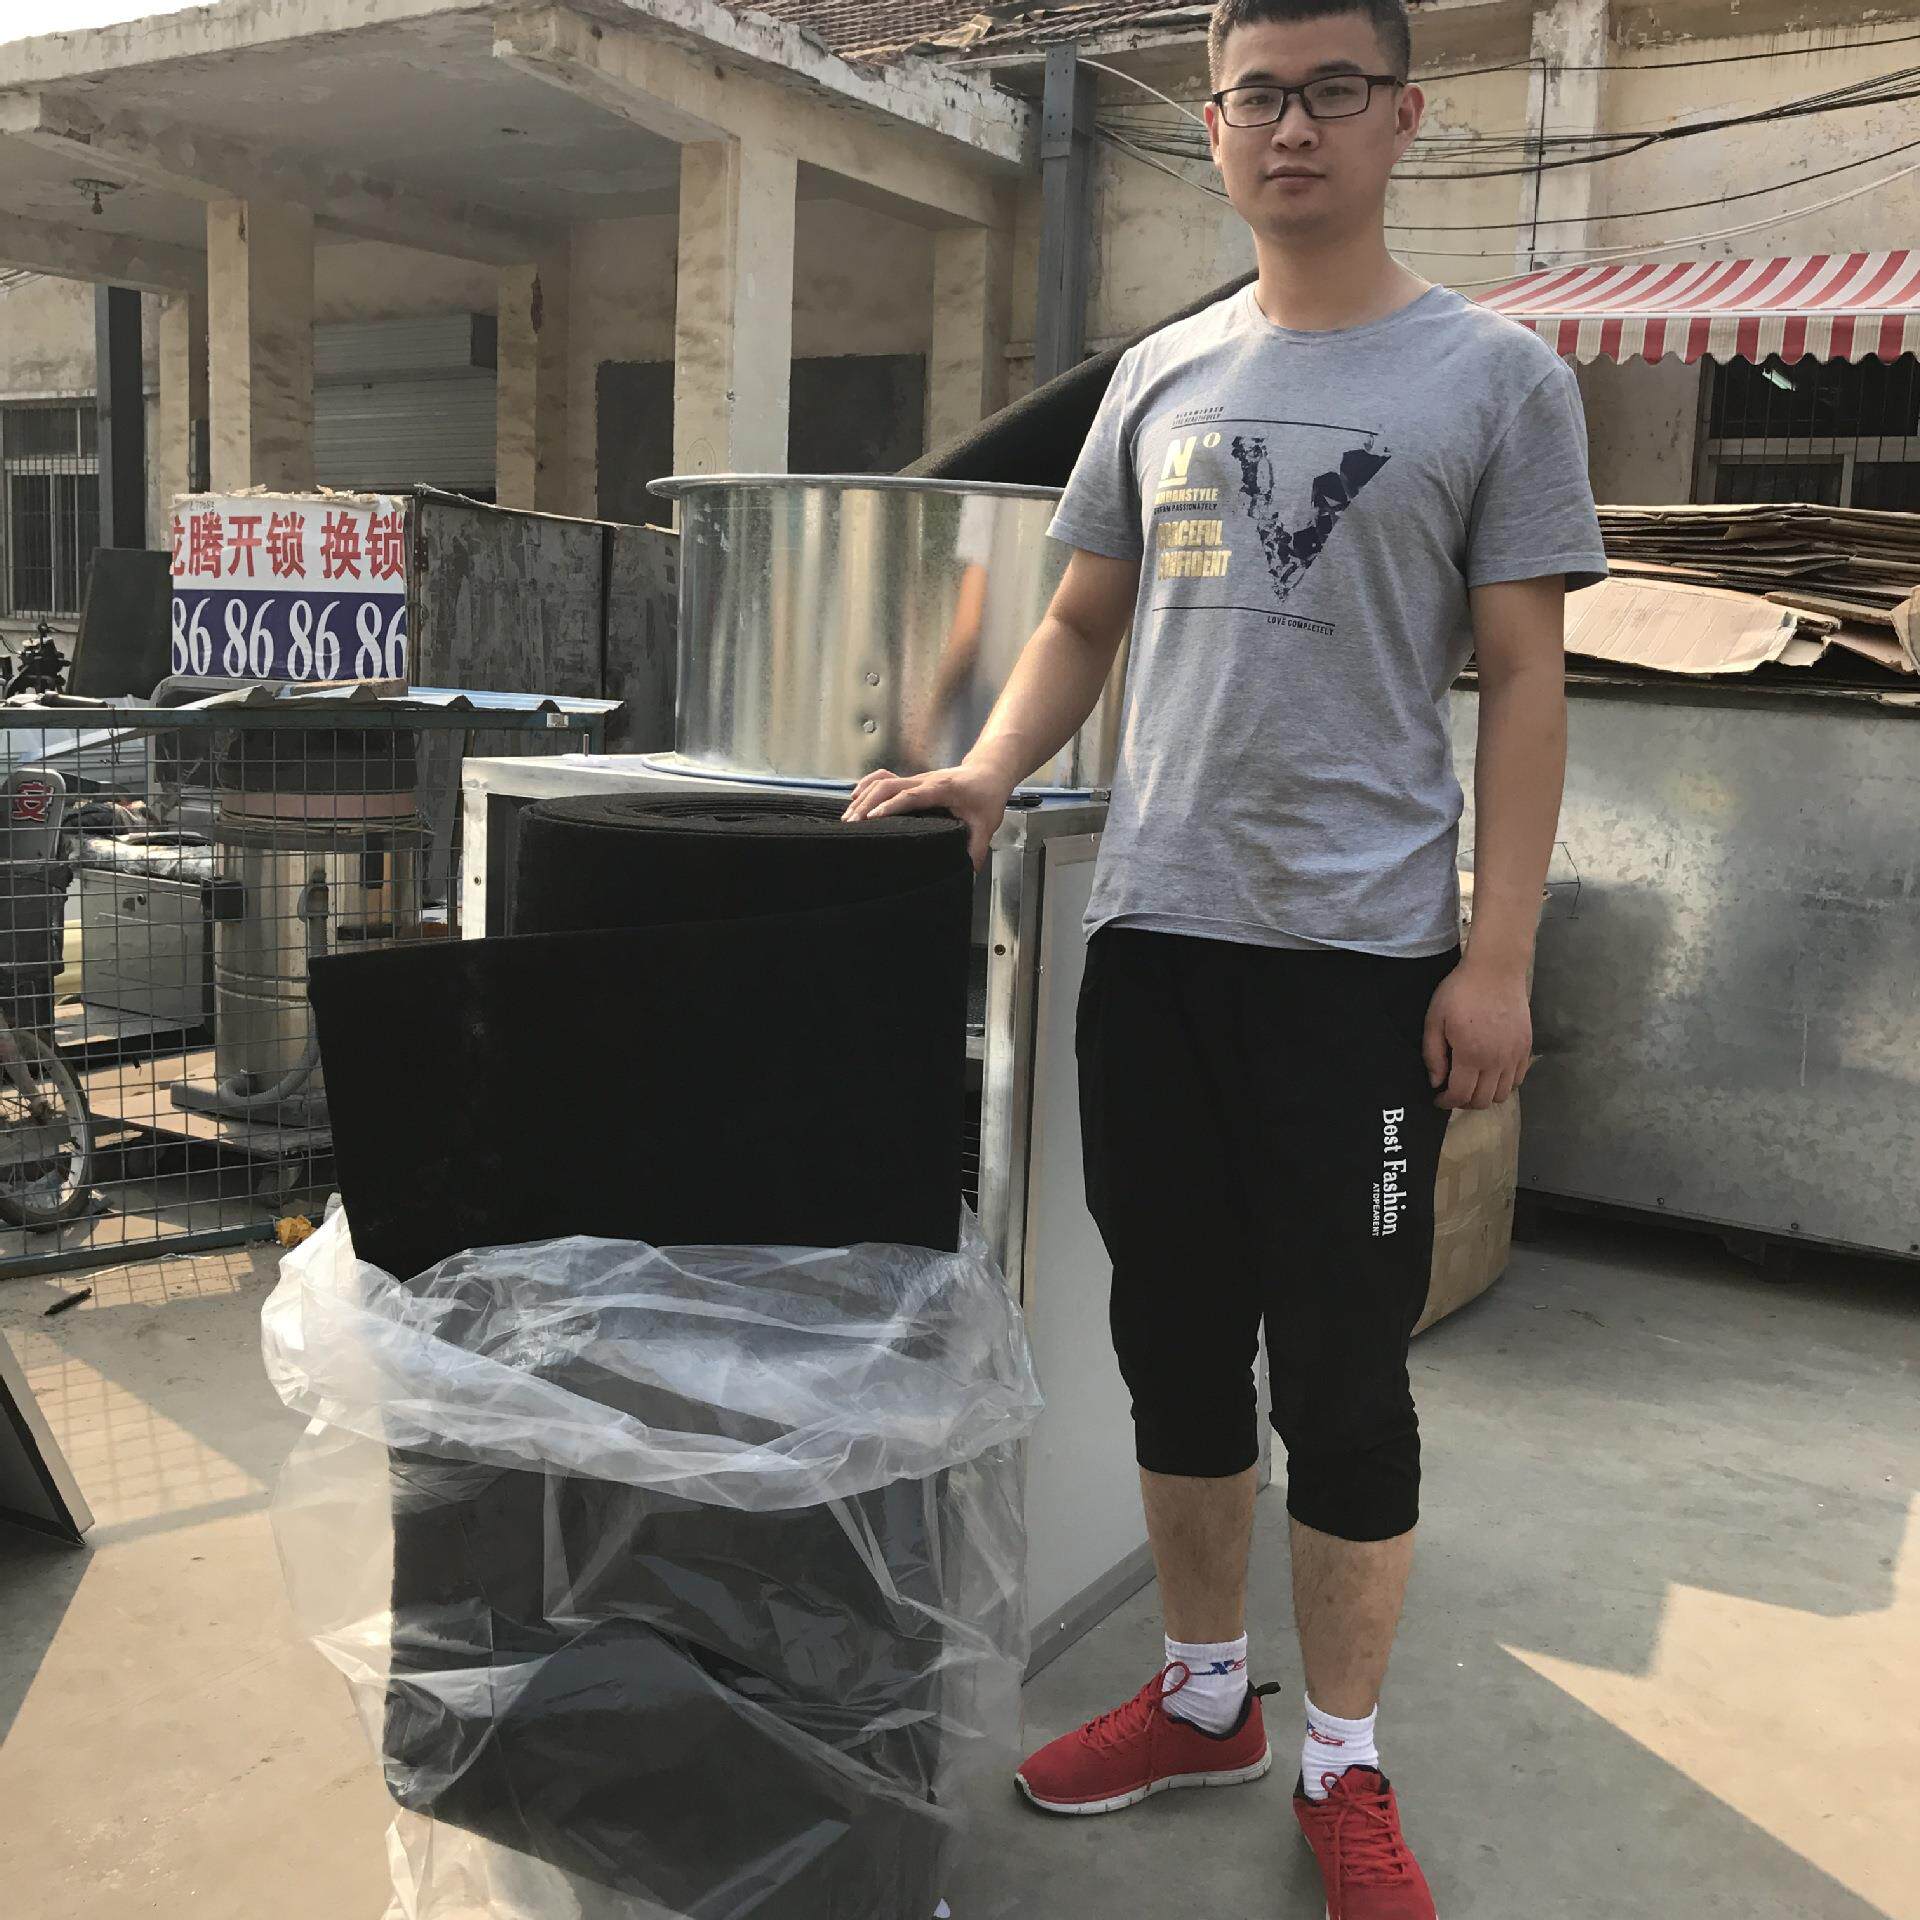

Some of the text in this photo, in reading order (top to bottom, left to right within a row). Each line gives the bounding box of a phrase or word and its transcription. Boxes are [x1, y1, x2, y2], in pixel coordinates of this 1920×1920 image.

[320, 511, 405, 580] 换锁
[1266, 615, 1335, 636] LOVE COMPLETELY
[1382, 1107, 1407, 1236] Best Fashion
